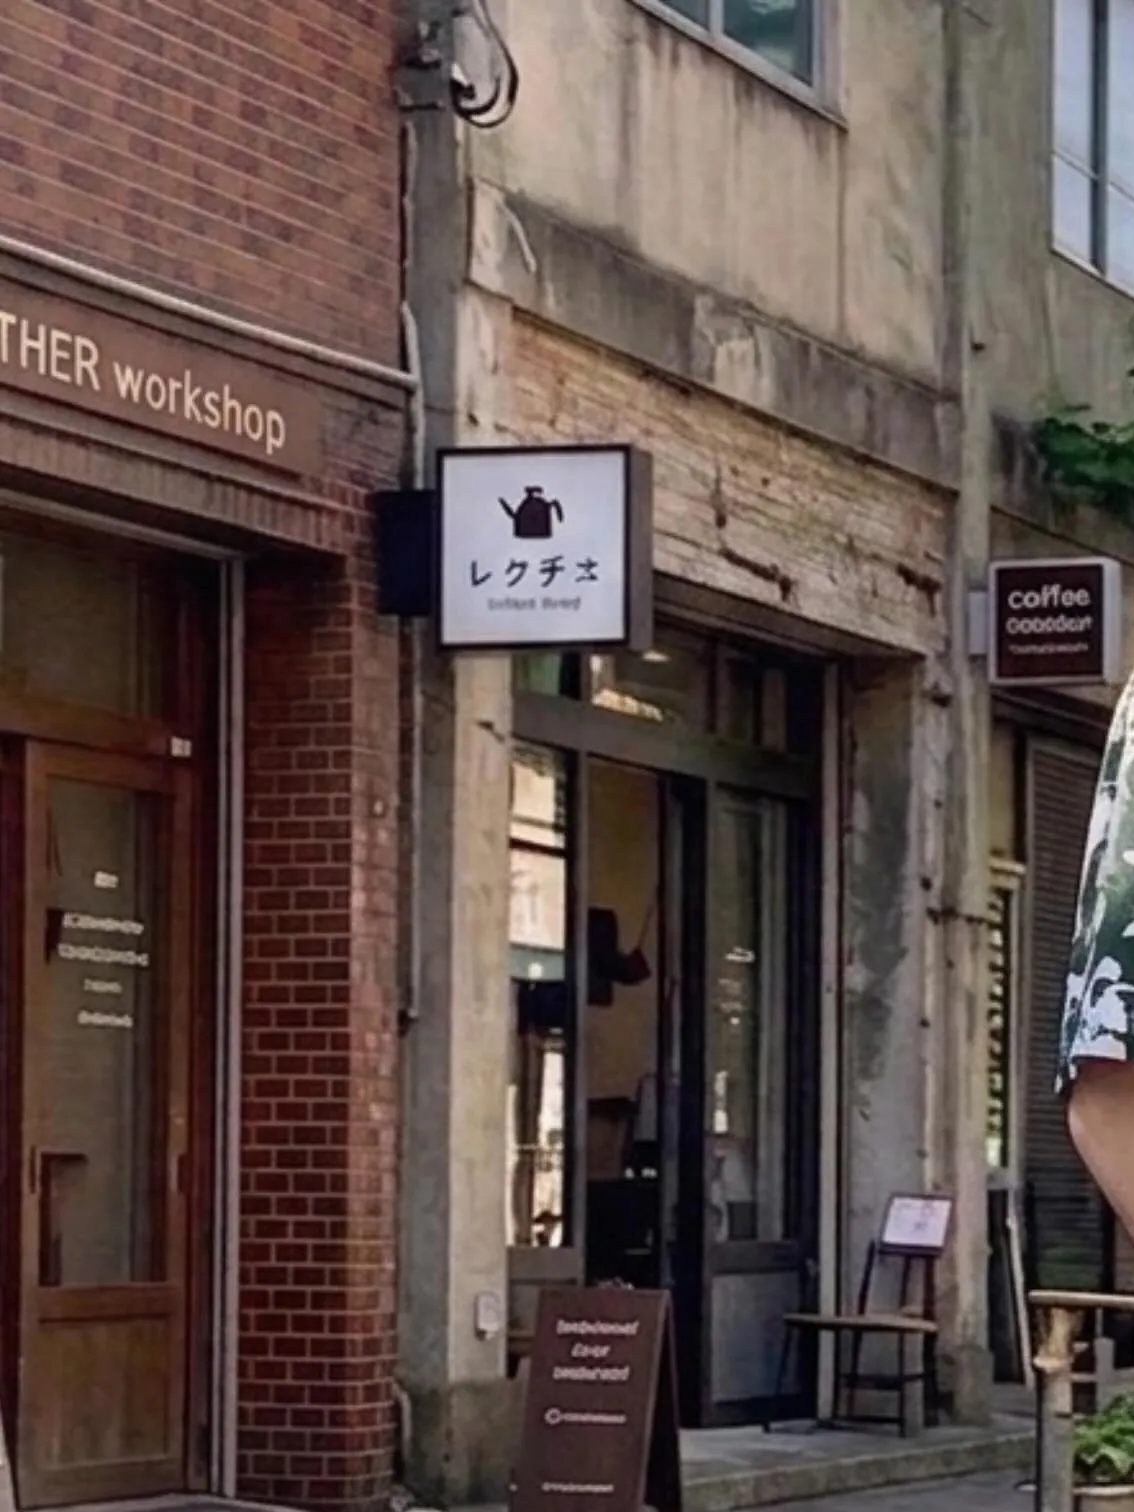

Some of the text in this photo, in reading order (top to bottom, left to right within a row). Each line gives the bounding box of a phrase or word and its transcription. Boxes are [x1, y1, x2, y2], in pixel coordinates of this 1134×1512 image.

[0, 310, 286, 454] THER workshop
[1007, 583, 1090, 610] coffee
